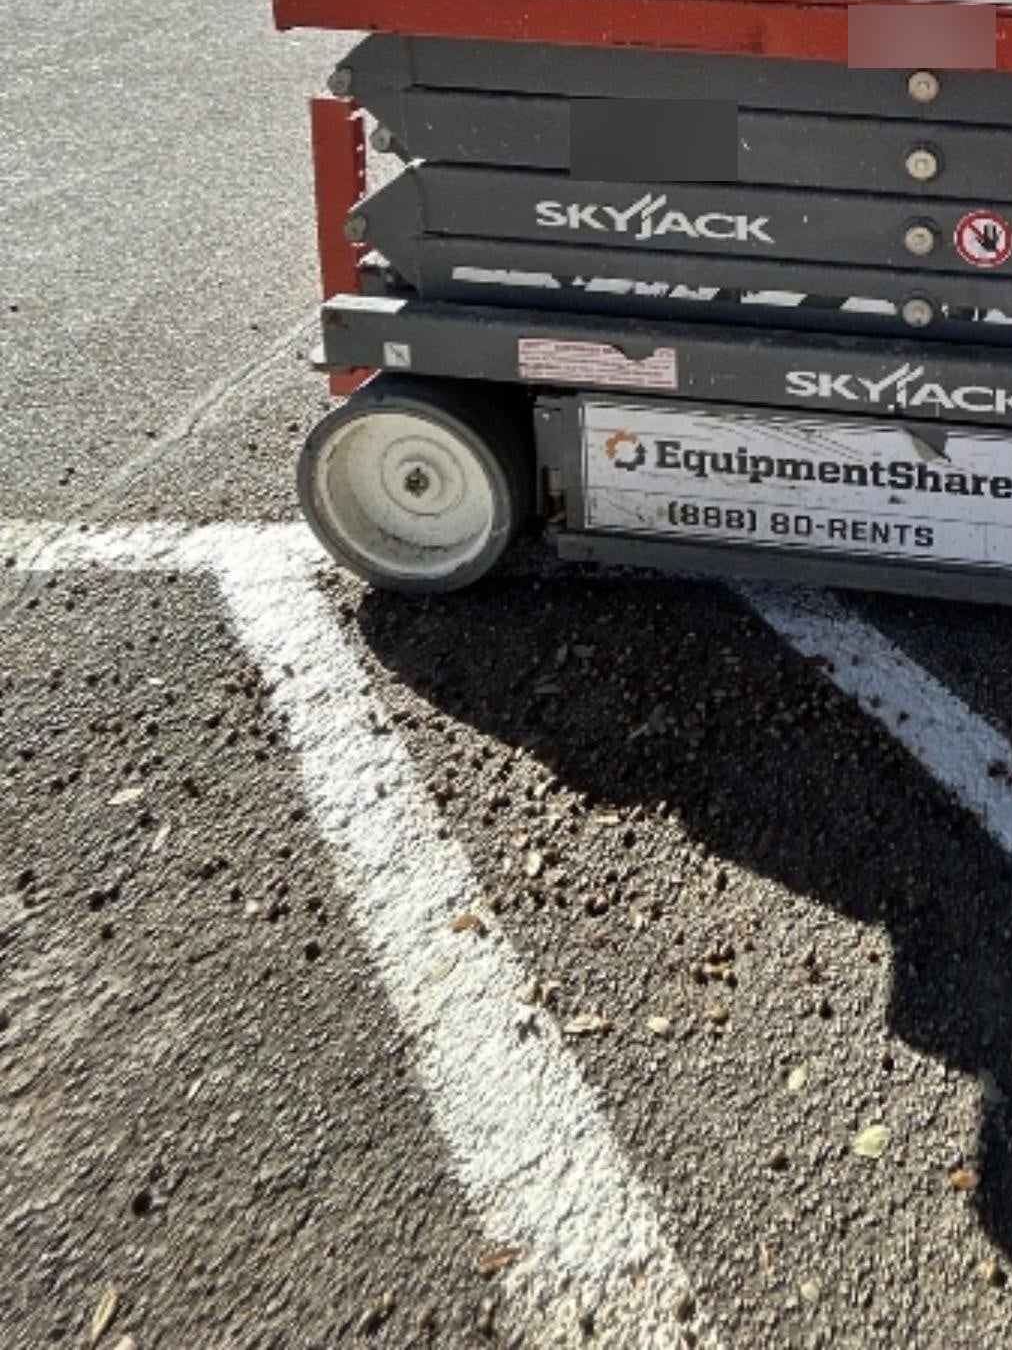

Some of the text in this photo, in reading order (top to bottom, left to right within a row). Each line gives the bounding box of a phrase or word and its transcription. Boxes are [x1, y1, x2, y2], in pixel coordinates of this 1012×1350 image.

[534, 192, 774, 244] SKYJACK
[668, 501, 934, 548] (888) 80-RENTS
